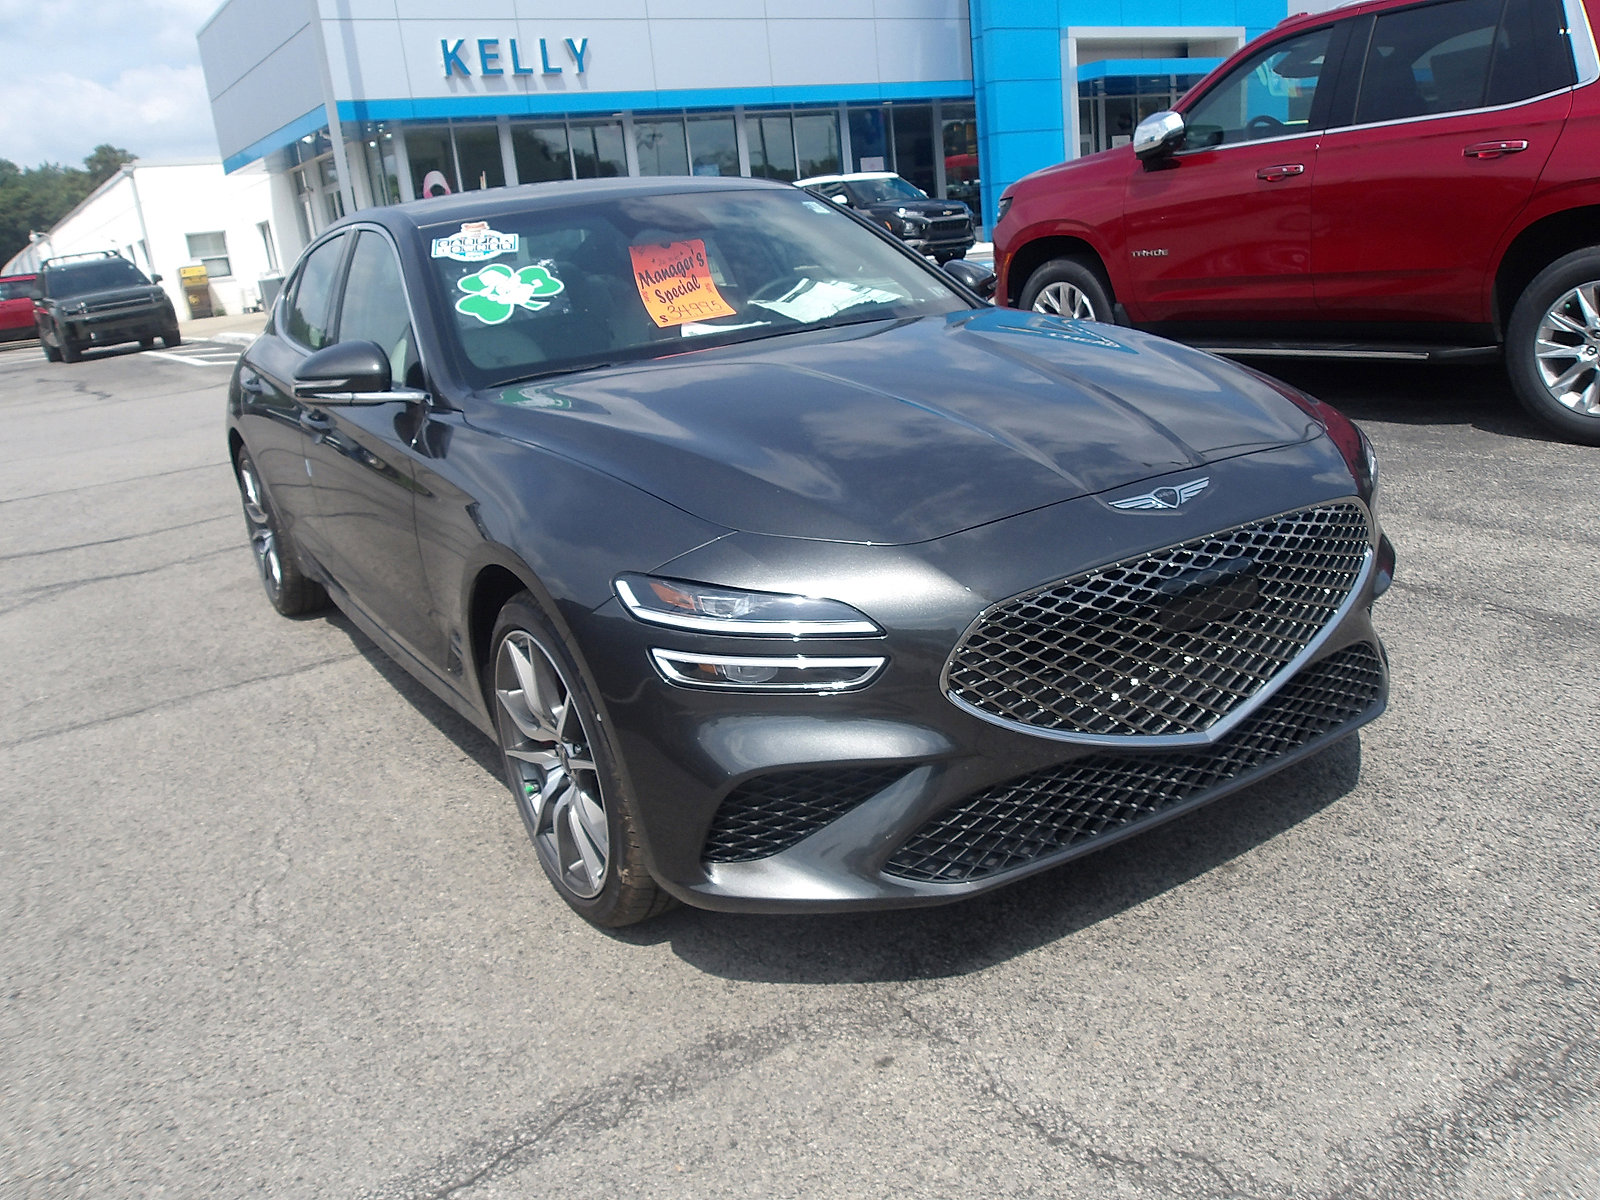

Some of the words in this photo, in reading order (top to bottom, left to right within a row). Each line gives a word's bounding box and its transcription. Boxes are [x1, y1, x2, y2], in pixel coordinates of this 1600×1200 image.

[440, 38, 588, 76] KELLY
[638, 250, 705, 289] Manager's
[655, 275, 701, 304] Special
